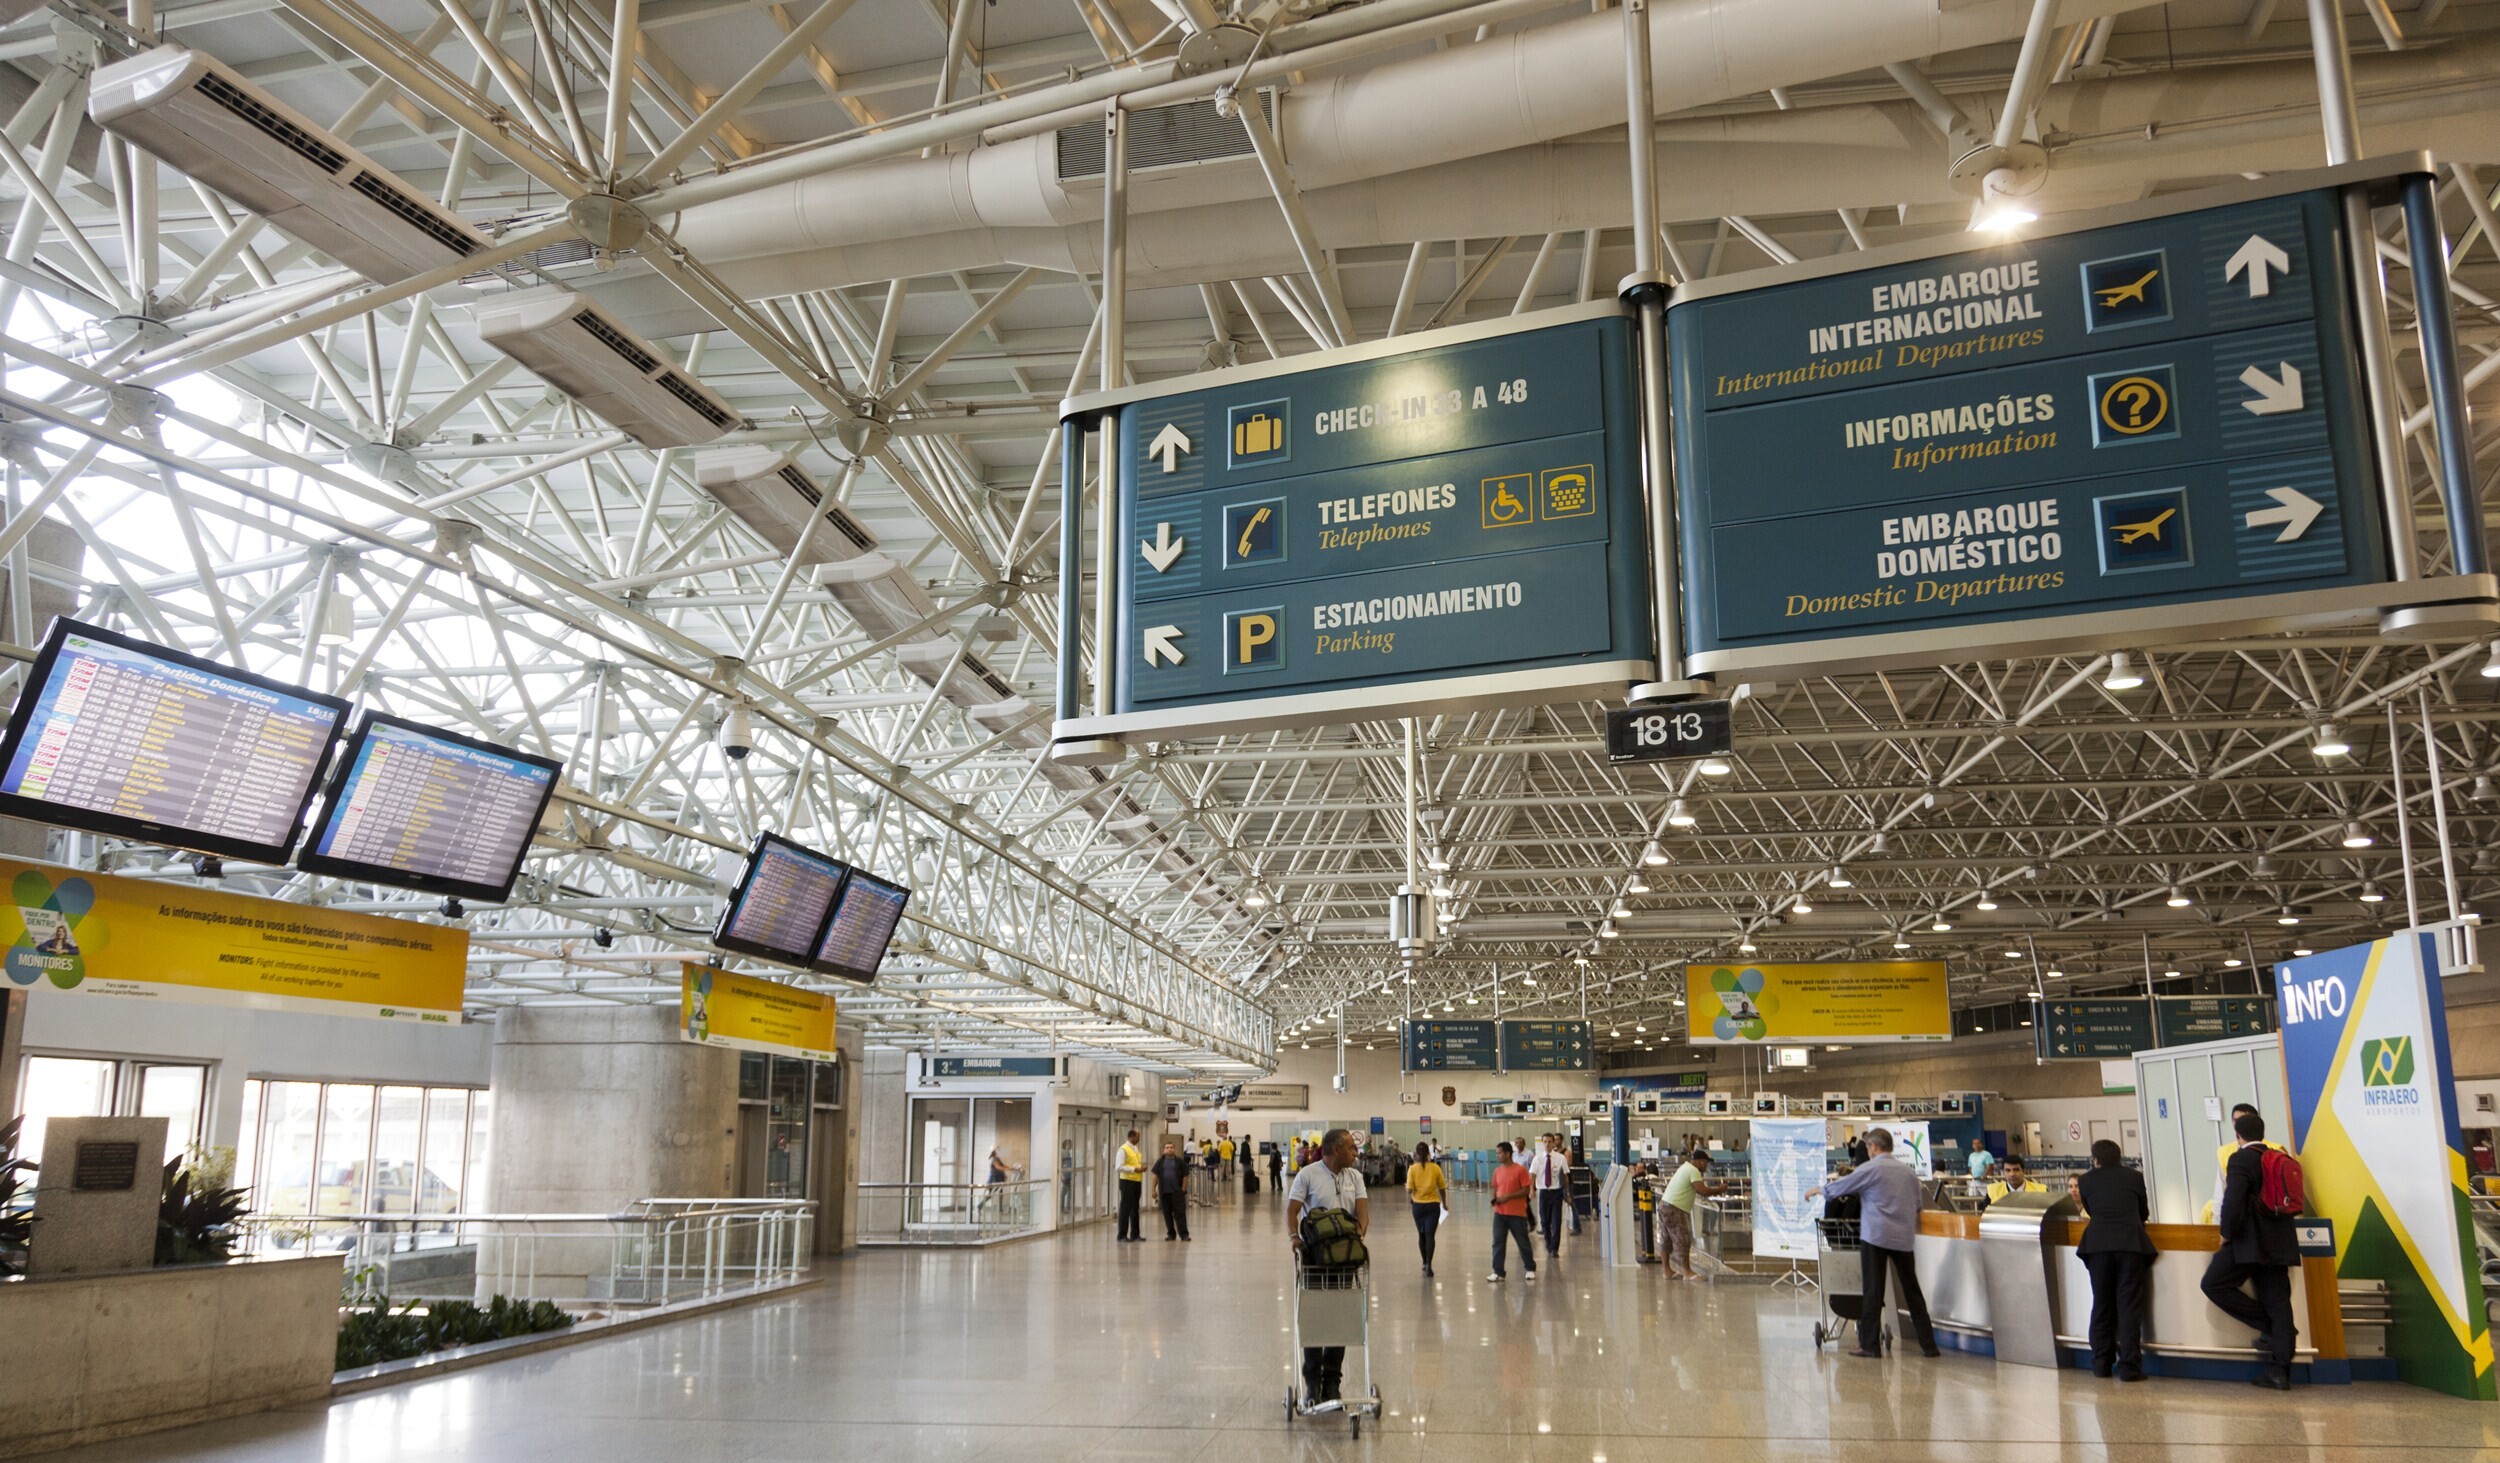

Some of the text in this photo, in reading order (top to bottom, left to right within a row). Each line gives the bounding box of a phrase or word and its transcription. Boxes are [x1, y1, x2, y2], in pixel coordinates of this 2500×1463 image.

[1872, 260, 2040, 312] EMBARQUE
[1809, 293, 2042, 354] INTERNACIONAL
[1715, 328, 2044, 397] International Departures
[1315, 378, 1528, 435] CHECK-IN 33 A 48
[1845, 394, 2054, 448] INFORMAÇÕES
[1891, 430, 2057, 473] Information
[1318, 483, 1457, 525] TELEFONES
[1882, 498, 2060, 546] EMBARQUE
[1318, 521, 1432, 551] Telephones
[1876, 532, 2062, 579] DOMÉSTICO
[1313, 581, 1522, 630] ESTACIONAMENTO
[1784, 570, 2065, 617] Domestic Departures
[1239, 614, 1276, 664] P
[1315, 629, 1395, 655] Parking
[153, 662, 209, 685] Partidas
[208, 678, 280, 704] Domésticas
[1630, 712, 1703, 746] 18 13
[426, 740, 468, 757] Domestic
[467, 751, 515, 770] Departures
[26, 917, 57, 928] DENTRO
[159, 905, 170, 916] As
[172, 907, 227, 925] informações
[229, 914, 253, 927] sobre
[254, 919, 264, 929] os
[266, 921, 285, 932] voos
[287, 922, 301, 933] são
[302, 923, 343, 940] fornecidas
[344, 931, 365, 942] pelas
[18, 953, 74, 971] MONITORES
[218, 953, 255, 966] MONITORS:
[255, 957, 274, 969] Flight
[963, 1058, 1002, 1068] EMBARQUE
[1679, 1073, 1706, 1086] LIBERTY
[2364, 1088, 2419, 1106] INFRAERO
[2366, 1106, 2421, 1116] AEROPORTOS
